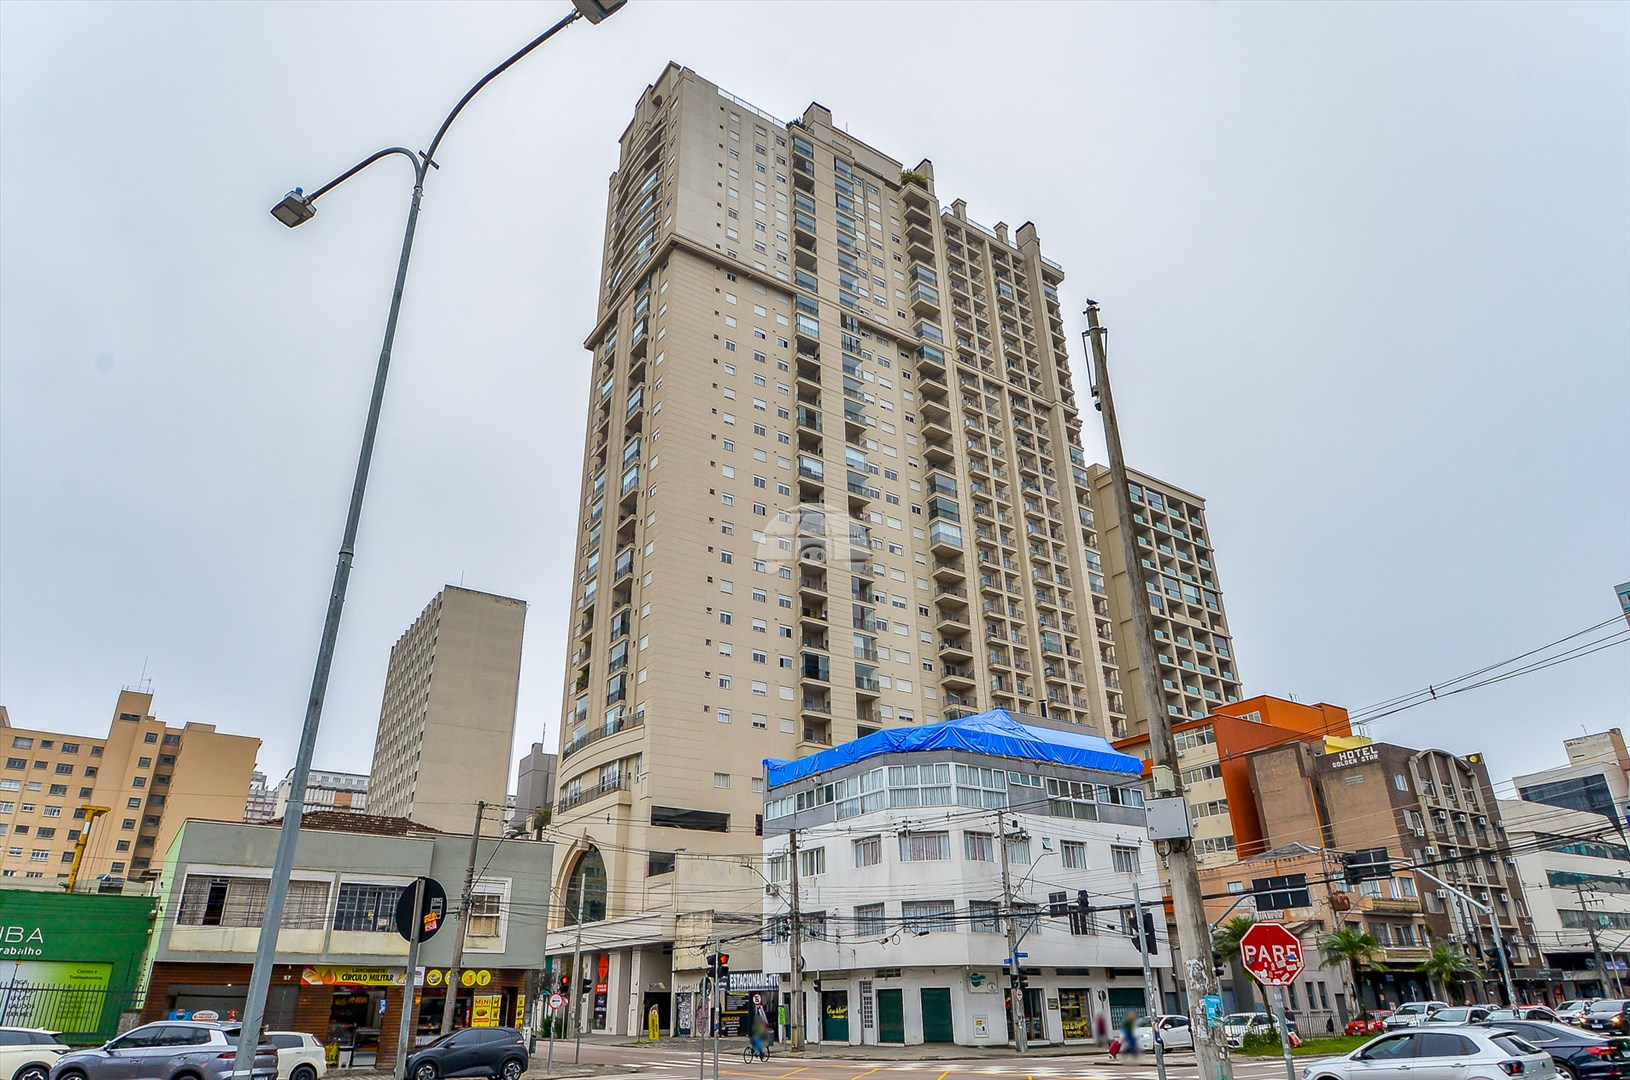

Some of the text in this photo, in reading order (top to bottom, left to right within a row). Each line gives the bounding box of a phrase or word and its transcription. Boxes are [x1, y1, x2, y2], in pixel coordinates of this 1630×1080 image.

[1338, 746, 1378, 760] HOTEL
[1332, 753, 1379, 768] GOLDEN STAR
[0, 926, 44, 943] IBA
[0, 947, 42, 956] rabalho
[1244, 945, 1299, 962] PARE
[369, 974, 395, 982] MILITAR
[730, 973, 780, 987] ESTACIONAMENTO
